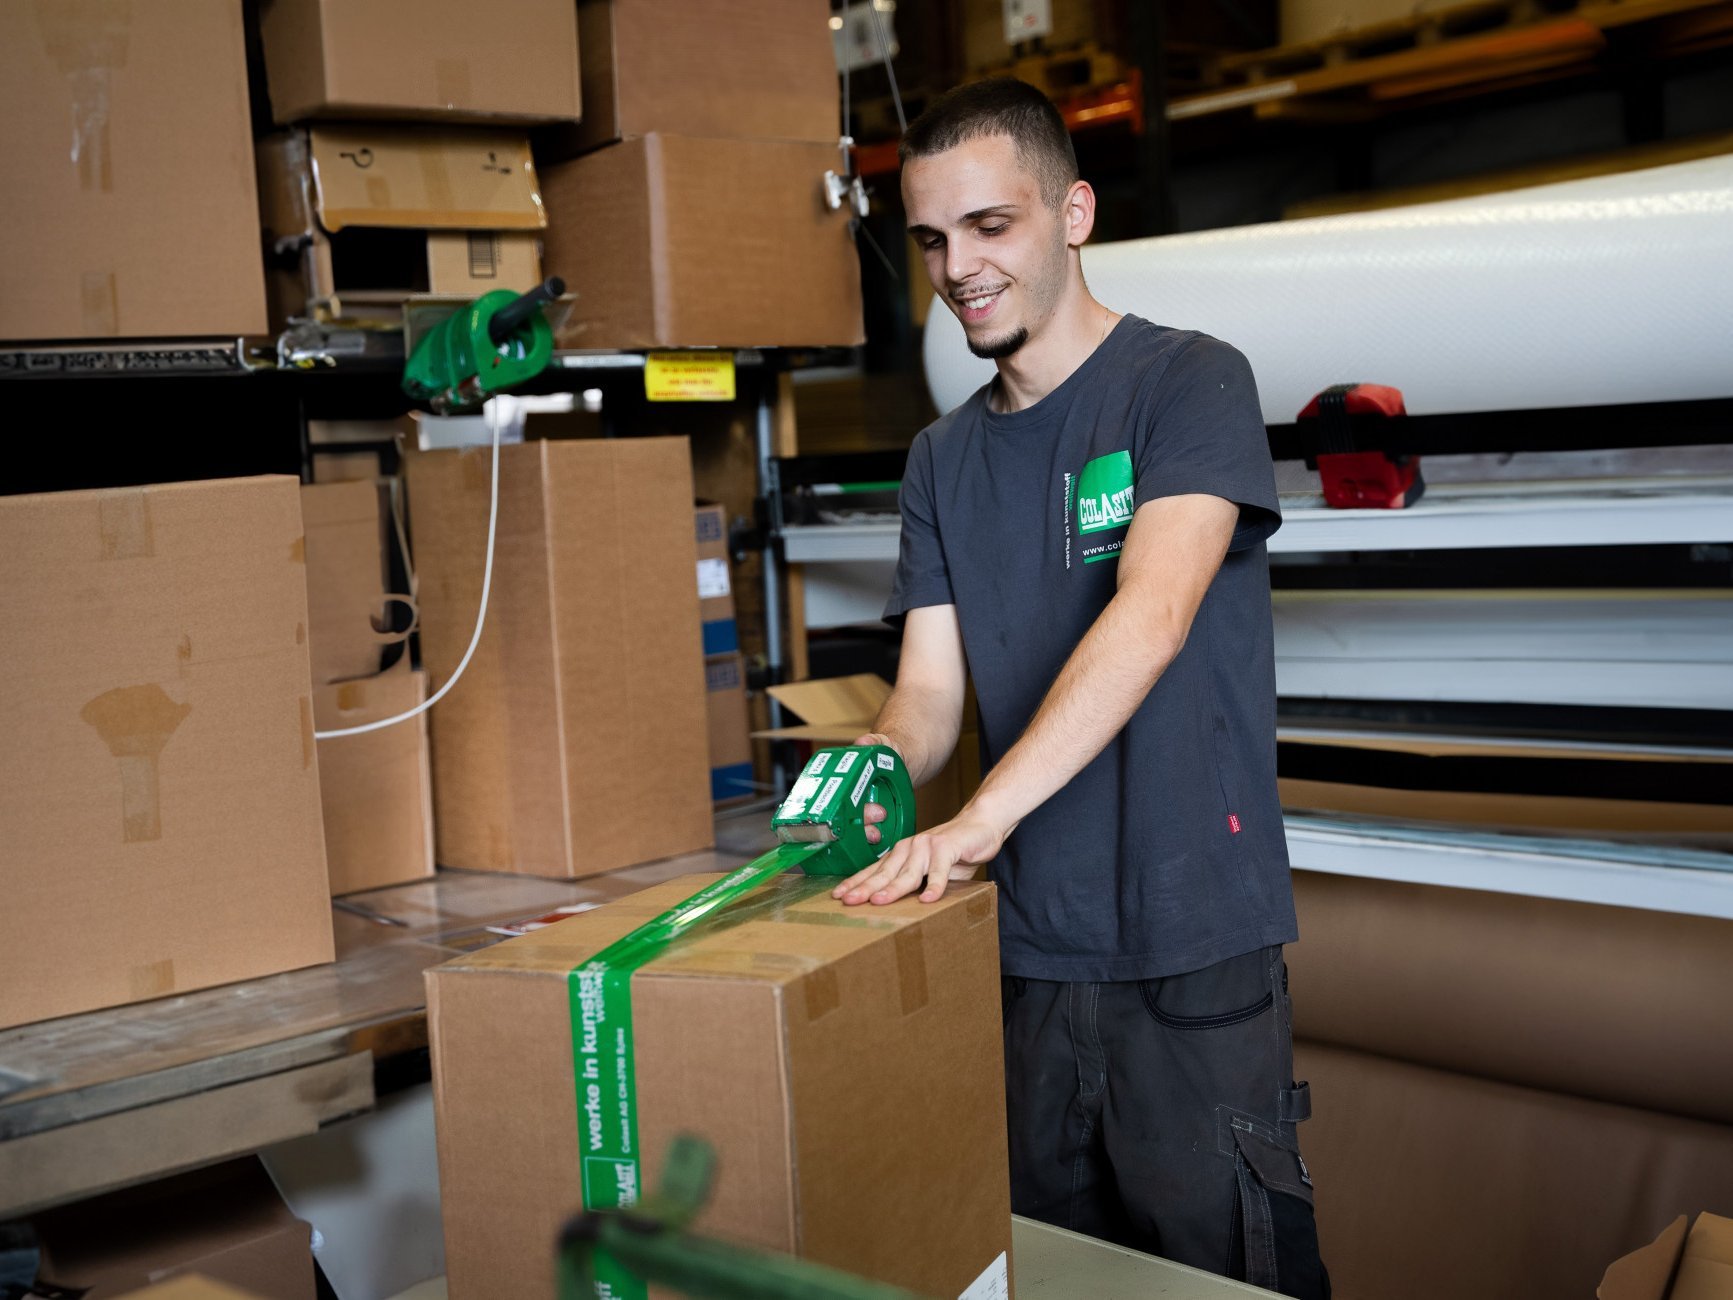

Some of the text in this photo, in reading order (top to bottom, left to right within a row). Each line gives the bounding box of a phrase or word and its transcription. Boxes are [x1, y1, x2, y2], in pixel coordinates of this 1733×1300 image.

[1065, 526, 1070, 535] in
[582, 1058, 599, 1079] in
[585, 1083, 603, 1151] werke
[619, 1101, 628, 1117] AG
